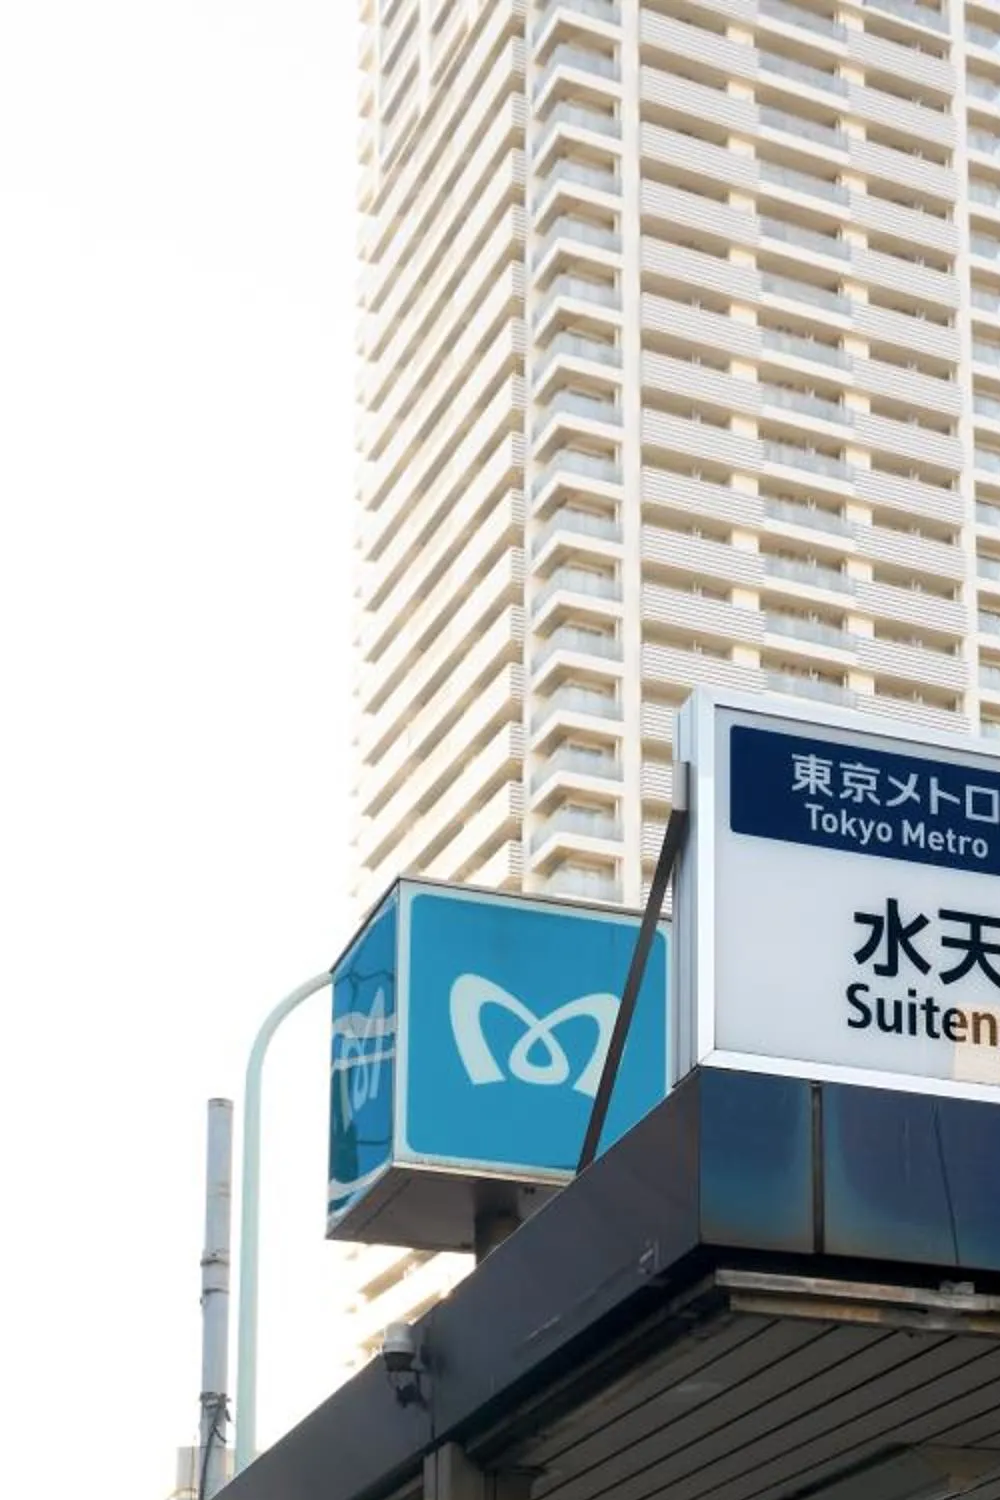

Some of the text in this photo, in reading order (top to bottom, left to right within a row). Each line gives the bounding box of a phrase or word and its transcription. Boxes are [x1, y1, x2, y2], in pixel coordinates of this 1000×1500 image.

[791, 751, 1000, 825] 東京メトロ
[805, 803, 989, 860] Tokyo Metro
